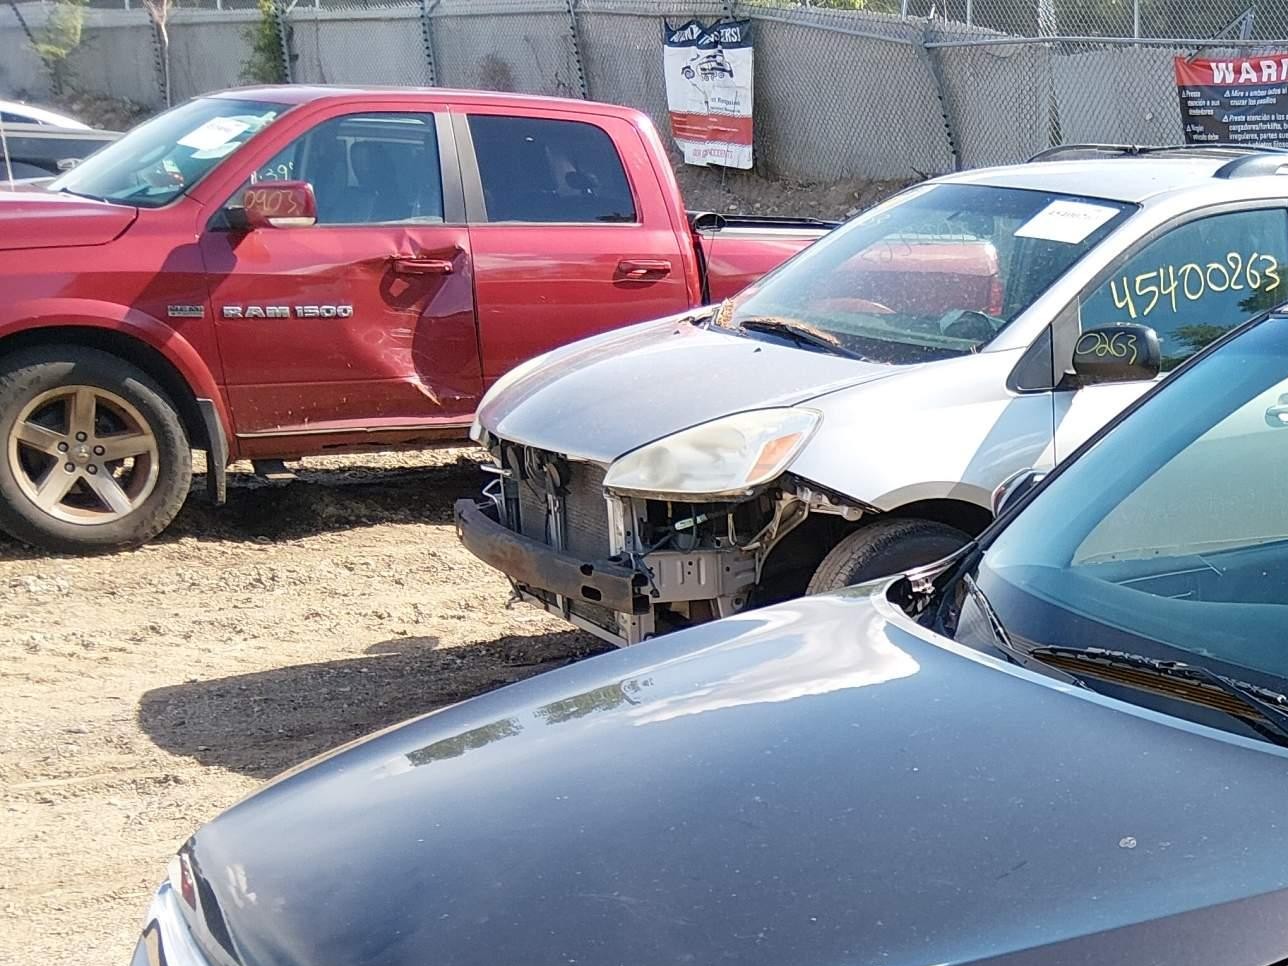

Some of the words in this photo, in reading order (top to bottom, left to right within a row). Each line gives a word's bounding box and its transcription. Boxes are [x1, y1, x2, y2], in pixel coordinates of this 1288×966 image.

[1110, 252, 1281, 319] 45400263
[223, 306, 290, 318] RAM
[295, 305, 354, 318] 1500
[1075, 331, 1137, 366] 0263
